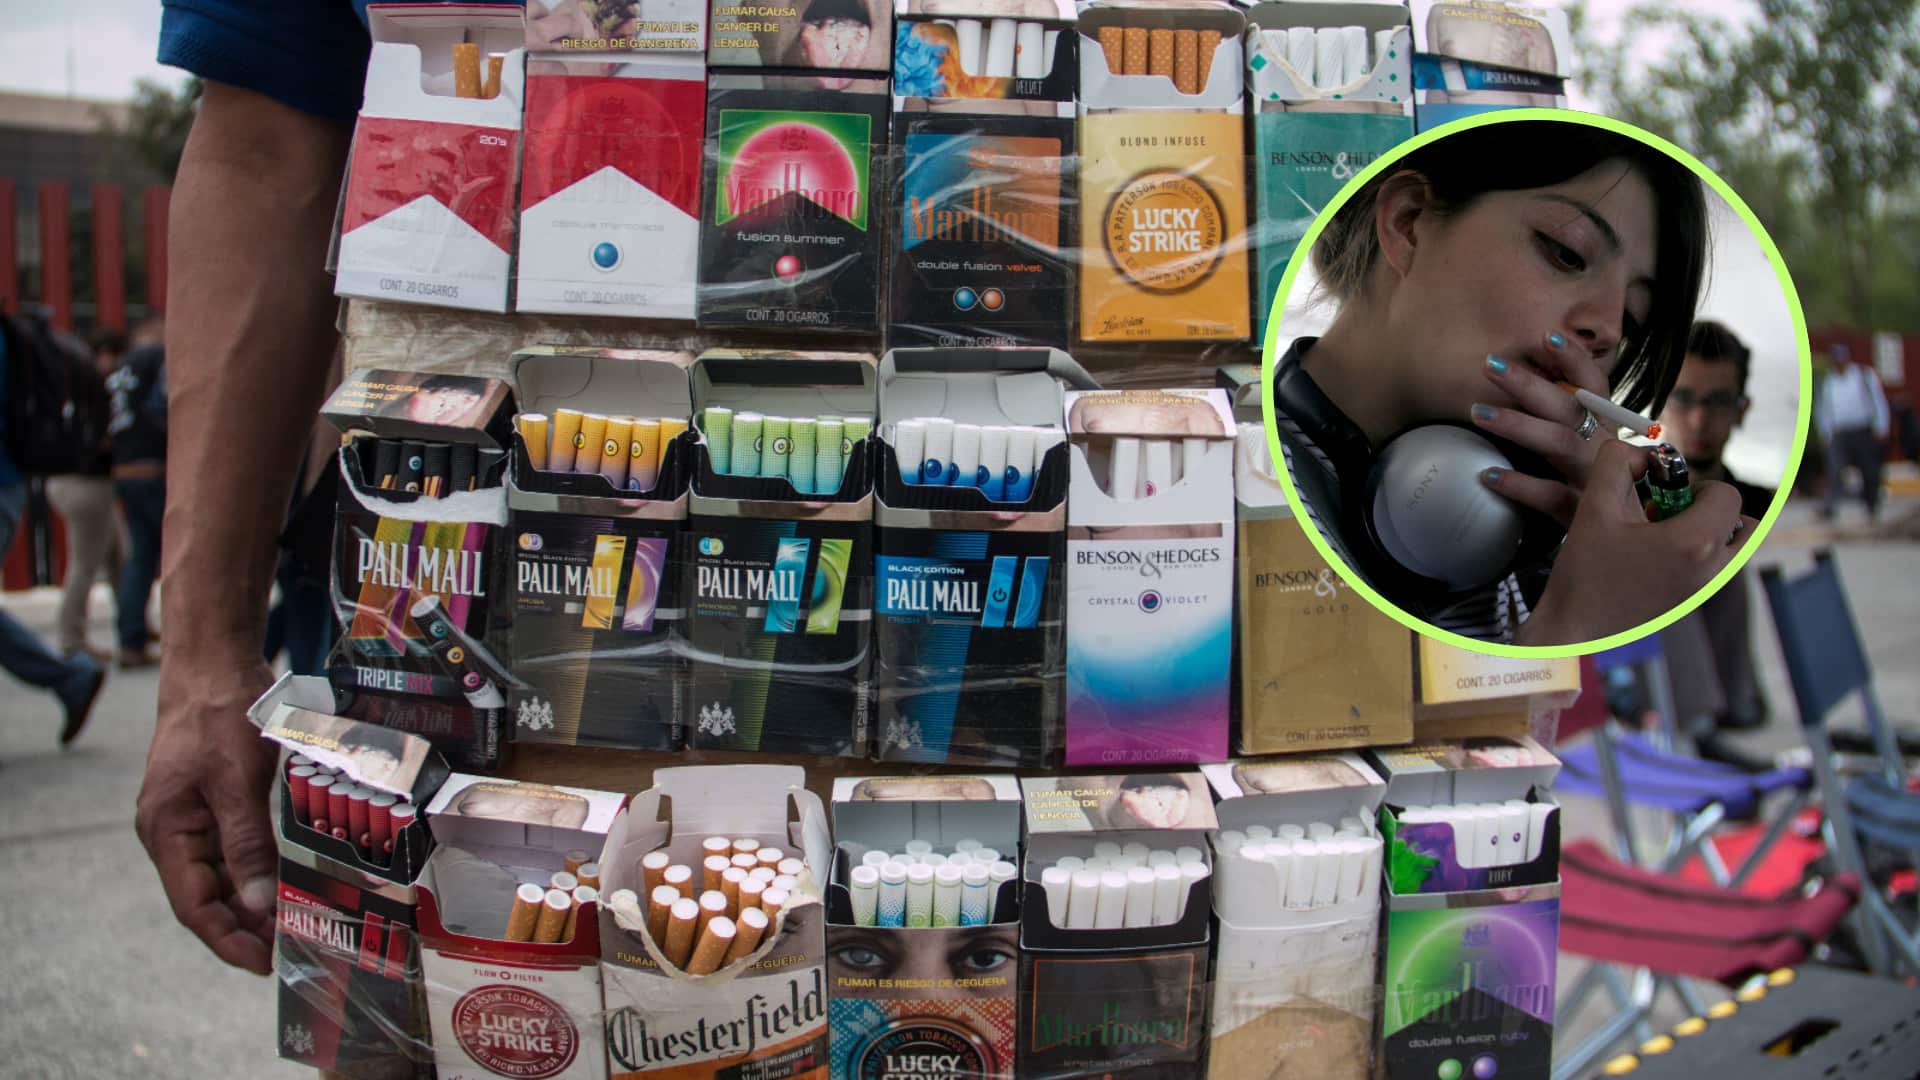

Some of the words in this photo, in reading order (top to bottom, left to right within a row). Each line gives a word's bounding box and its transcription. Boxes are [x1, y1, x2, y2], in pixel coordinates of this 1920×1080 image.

[715, 5, 756, 17] FUMAR
[758, 6, 798, 17] CAUSA
[636, 21, 680, 33] FUMAR
[683, 22, 699, 33] ES
[714, 22, 762, 33] CANCER
[764, 23, 780, 33] DE
[561, 38, 607, 48] RIESGO
[610, 38, 626, 48] DE
[629, 38, 699, 48] GANGRENA
[713, 38, 760, 49] LENGUA
[1015, 81, 1043, 95] VELVET
[479, 135, 507, 147] 20's
[1120, 136, 1159, 147] BLOND
[1164, 136, 1207, 147] INFUSE
[1271, 151, 1334, 166] BENSON
[1331, 151, 1354, 179] &
[724, 163, 863, 221] Marlboro
[1132, 207, 1200, 230] LUCKY
[737, 231, 781, 242] fusion
[783, 232, 845, 245] summer
[1128, 230, 1201, 254] STRIKE
[917, 260, 960, 270] double
[963, 261, 1003, 271] fusion
[1006, 263, 1043, 273] velvet
[405, 281, 417, 294] 20
[418, 282, 460, 298] CIGARROS
[601, 291, 649, 306] CIGARROS
[774, 309, 785, 321] 20
[786, 310, 830, 324] CIGARROS
[357, 537, 415, 589] PALL
[417, 545, 486, 597] MALL
[887, 564, 922, 573] BLACK
[923, 566, 966, 575] EDITION
[1076, 550, 1142, 565] BENSON
[1139, 551, 1162, 579] &
[1155, 547, 1221, 564] HEDGES
[517, 560, 561, 595] PALL
[564, 564, 618, 599] MALL
[697, 566, 744, 600] PALL
[746, 569, 799, 602] MALL
[1255, 569, 1318, 588] BENSON
[1314, 568, 1338, 601] &
[887, 577, 930, 611] PALL
[931, 580, 981, 613] MALL
[1087, 596, 1136, 606] CRYSTAL
[1165, 594, 1208, 605] VIOLET
[1303, 603, 1351, 616] GOLD
[356, 666, 403, 691] TRIPLE
[406, 672, 434, 695] MIX
[1487, 674, 1501, 686] 20
[1502, 669, 1553, 686] CIGARROS
[1130, 750, 1142, 761] 20
[1143, 748, 1191, 761] CIGARROS
[1074, 789, 1114, 798] CAUSA
[1083, 800, 1099, 808] DE
[284, 904, 318, 939] PALL
[319, 917, 358, 954] MALL
[616, 951, 658, 968] FUMAR
[513, 973, 544, 983] FILTER
[837, 977, 877, 988] FUMAR
[879, 978, 893, 988] ES
[895, 978, 935, 989] RIESGO
[938, 978, 952, 989] DE
[954, 976, 1008, 989] CEGUERA
[479, 1012, 550, 1036] LUCKY
[607, 967, 826, 1072] Chesterfield
[477, 1029, 554, 1054] STRIKE
[1408, 1035, 1453, 1049] double
[1456, 1032, 1496, 1045] fusion
[886, 1055, 961, 1073] LUCKY
